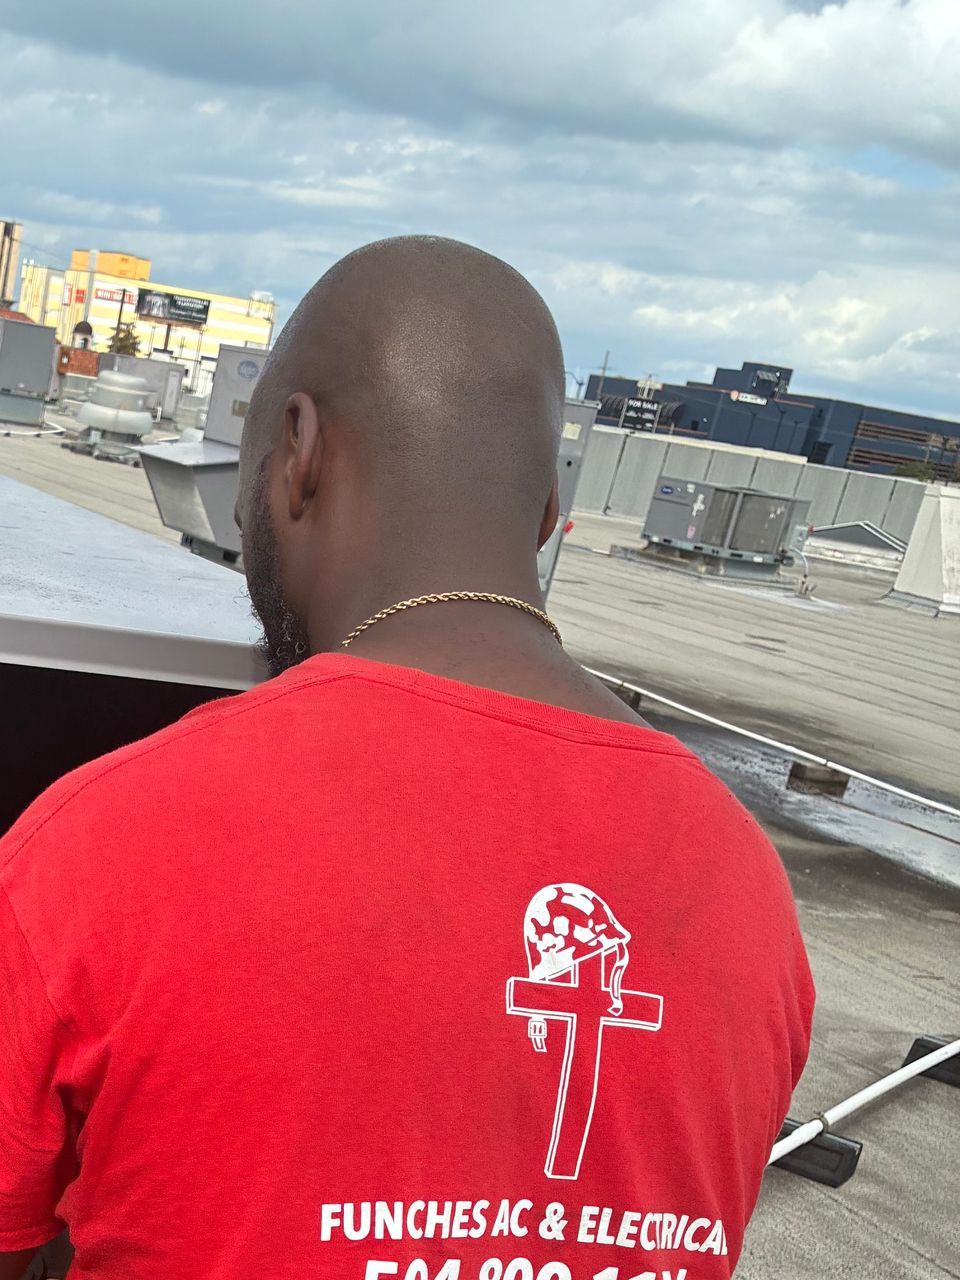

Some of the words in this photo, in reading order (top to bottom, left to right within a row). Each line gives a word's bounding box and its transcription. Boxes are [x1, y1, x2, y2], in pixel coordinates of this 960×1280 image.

[321, 1199, 490, 1242] FUNCHES
[491, 1199, 534, 1237] AC
[539, 1202, 569, 1241] &
